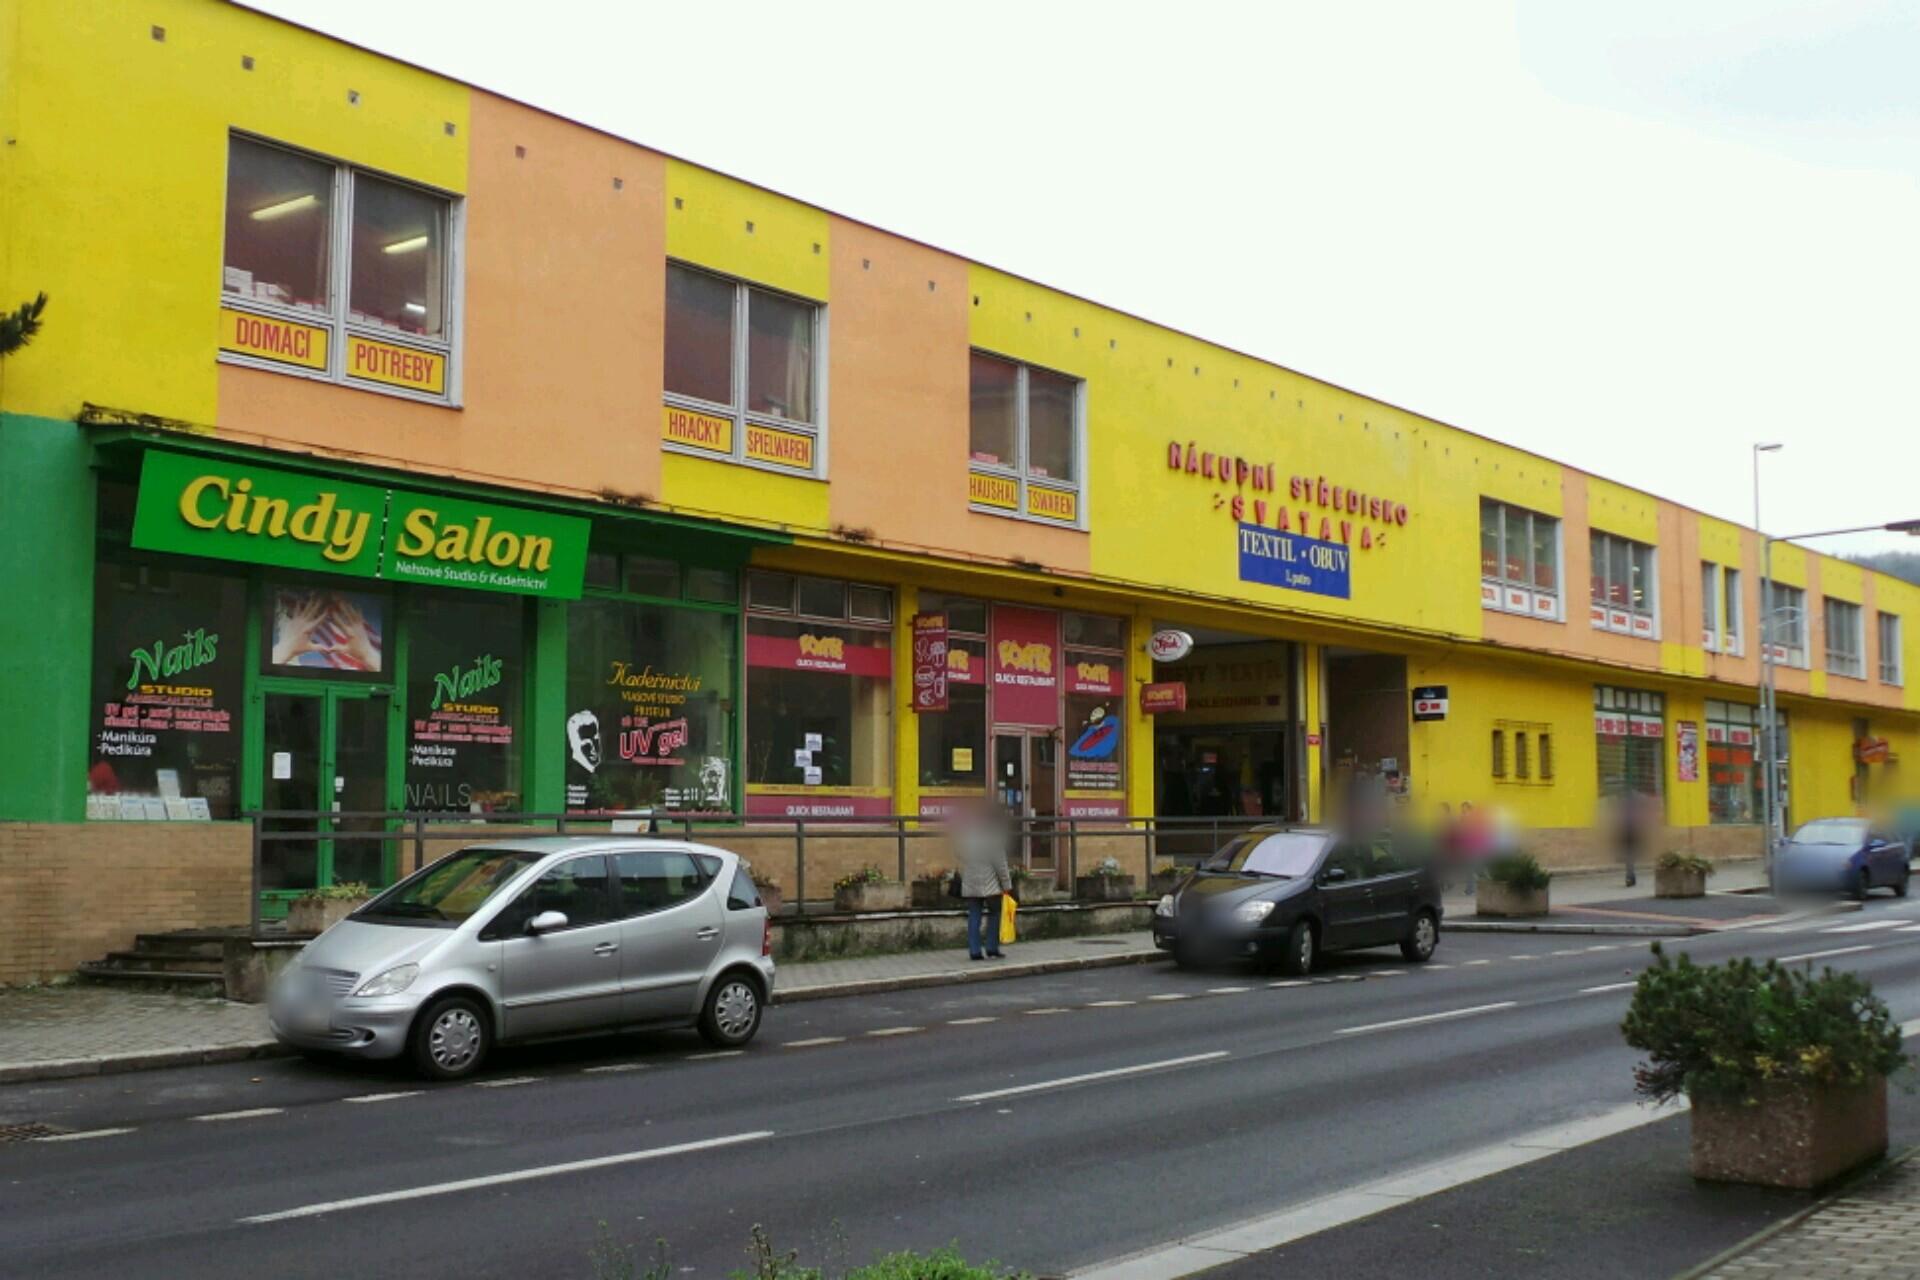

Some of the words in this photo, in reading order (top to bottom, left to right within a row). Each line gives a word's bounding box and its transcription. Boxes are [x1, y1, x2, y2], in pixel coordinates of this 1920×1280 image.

[355, 342, 434, 384] POTREBY
[746, 429, 810, 463] SPIELWAREN
[1168, 440, 1274, 492] NÁKUPNÍ
[1290, 475, 1408, 526] STŘEDISKO
[179, 474, 372, 562] Cindy
[395, 508, 553, 572] Salon
[1230, 494, 1373, 550] SVATAVA
[1239, 528, 1297, 563] TEXTIL
[1309, 545, 1349, 573] OBUV
[443, 566, 478, 584] Studio
[127, 628, 219, 690] Nails
[140, 684, 214, 697] STUDIO
[430, 653, 503, 710] Nails
[442, 702, 500, 715] STUDIO
[404, 783, 472, 807] NAILS
